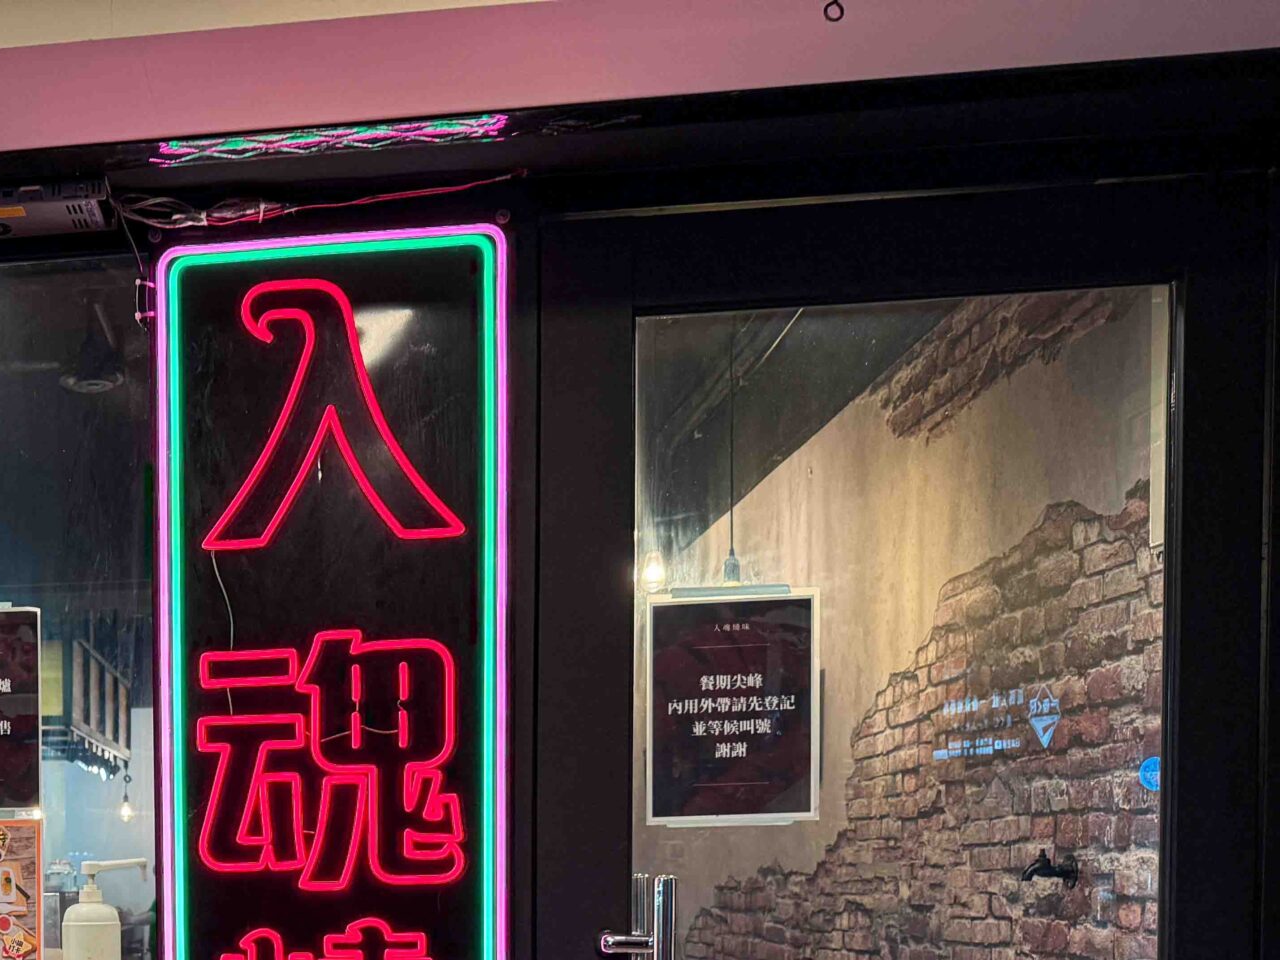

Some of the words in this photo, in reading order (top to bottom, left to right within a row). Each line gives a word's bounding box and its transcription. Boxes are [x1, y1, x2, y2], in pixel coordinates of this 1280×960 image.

[699, 673, 763, 691] 餐期尖峰
[668, 694, 796, 715] 內用外帶請先登記
[691, 718, 772, 737] 並等候叫號
[715, 742, 748, 758] 謝謝
